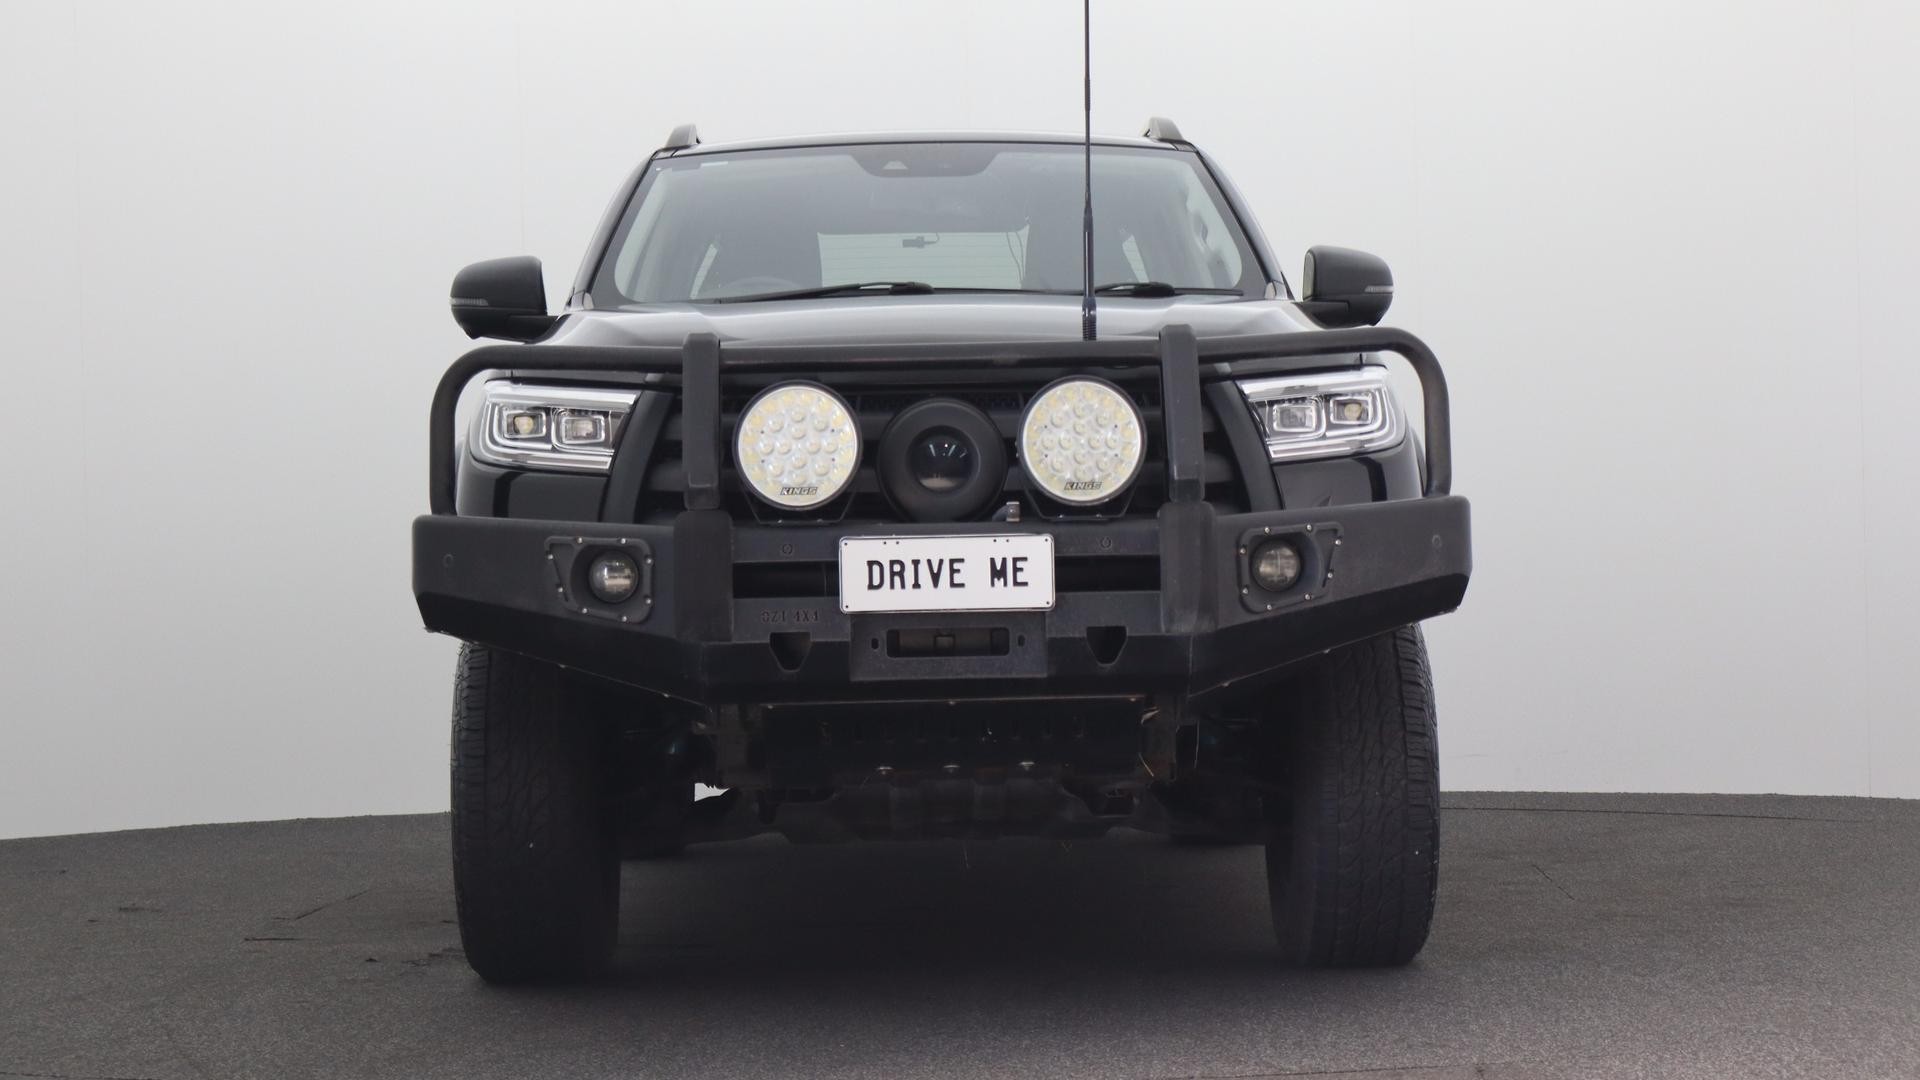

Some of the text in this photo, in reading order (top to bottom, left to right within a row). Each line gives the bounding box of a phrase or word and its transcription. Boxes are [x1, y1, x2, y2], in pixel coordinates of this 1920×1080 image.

[780, 486, 818, 496] KINGS
[1063, 481, 1102, 491] KINGS
[866, 556, 1029, 591] DRIVE ME
